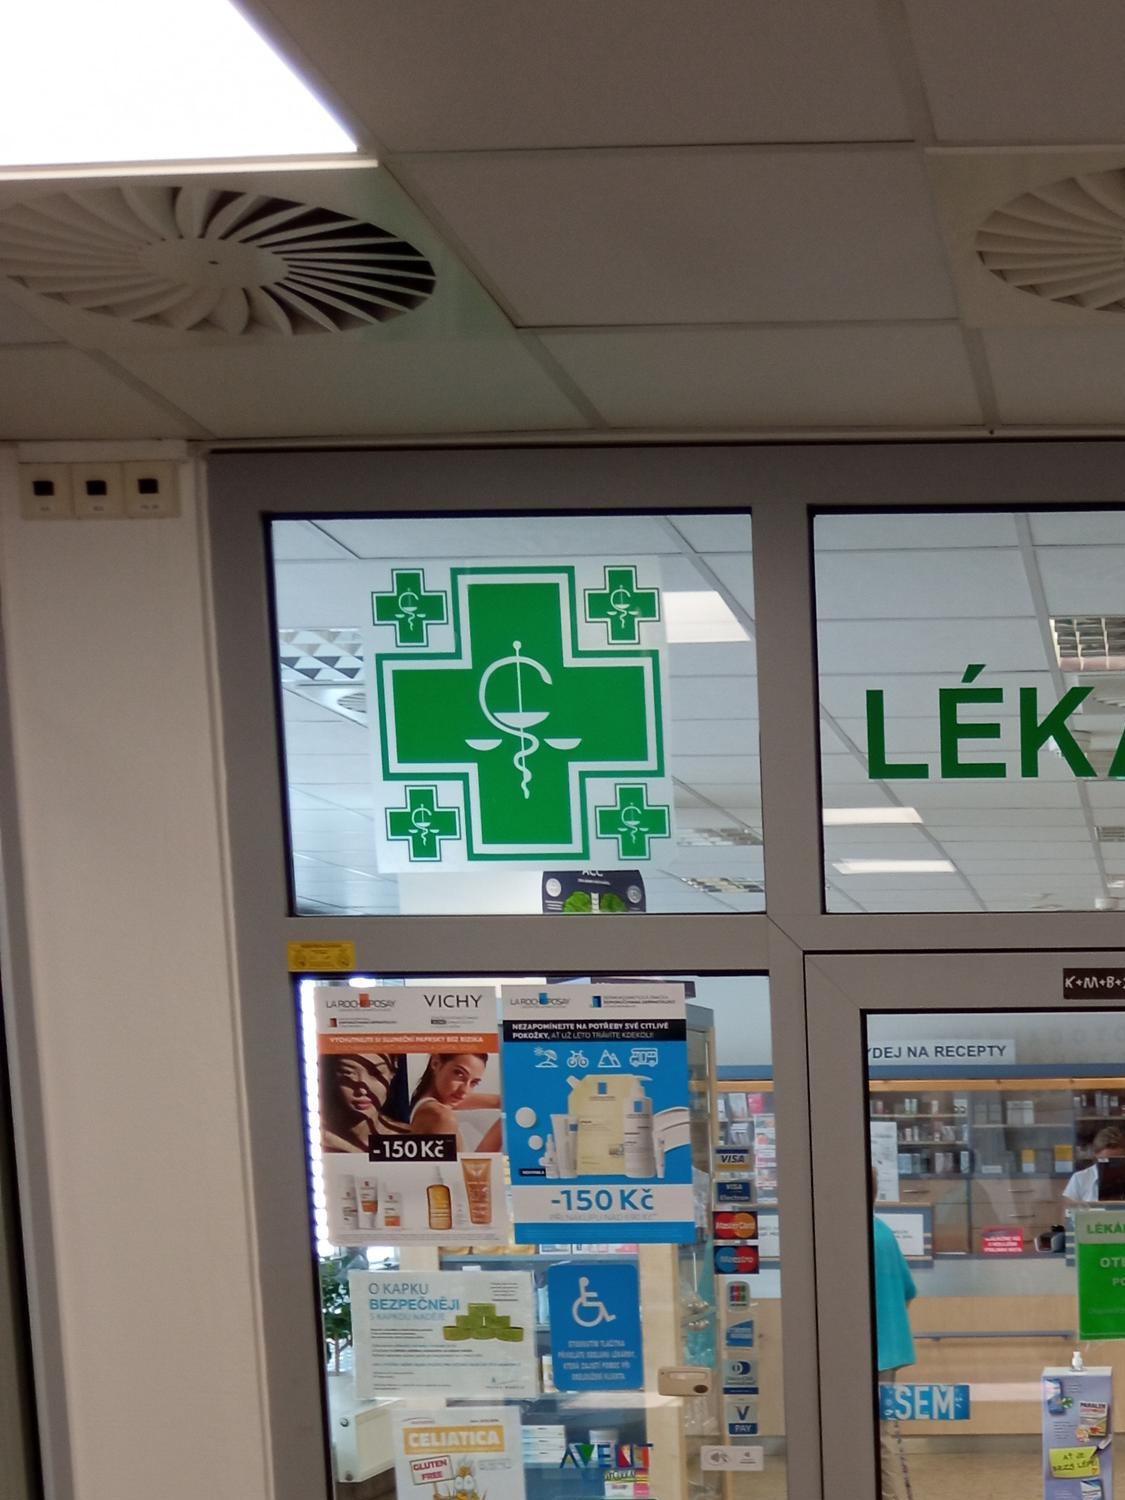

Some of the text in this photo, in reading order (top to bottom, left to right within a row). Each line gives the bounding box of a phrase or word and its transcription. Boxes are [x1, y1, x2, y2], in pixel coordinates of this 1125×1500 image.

[423, 994, 483, 1008] VICHY
[576, 1022, 588, 1030] NA
[588, 1021, 624, 1030] POTŘEBY
[625, 1021, 639, 1030] SVÉ
[640, 1021, 669, 1029] CITLIVÉ
[906, 1045, 929, 1058] NA
[934, 1045, 1007, 1058] RECEPTY
[373, 1140, 444, 1158] -150 Kč
[720, 1154, 745, 1164] VISA
[551, 1188, 654, 1212] -150 Kč
[368, 1282, 429, 1295] O KAPKU
[369, 1295, 460, 1311] BEZPEČNĚJI
[895, 1385, 954, 1420] SEM
[736, 1405, 750, 1421] V
[735, 1424, 752, 1433] PAY
[408, 1430, 500, 1447] CELIATICA
[413, 1459, 448, 1471] GLUTEN
[421, 1471, 443, 1480] FREE
